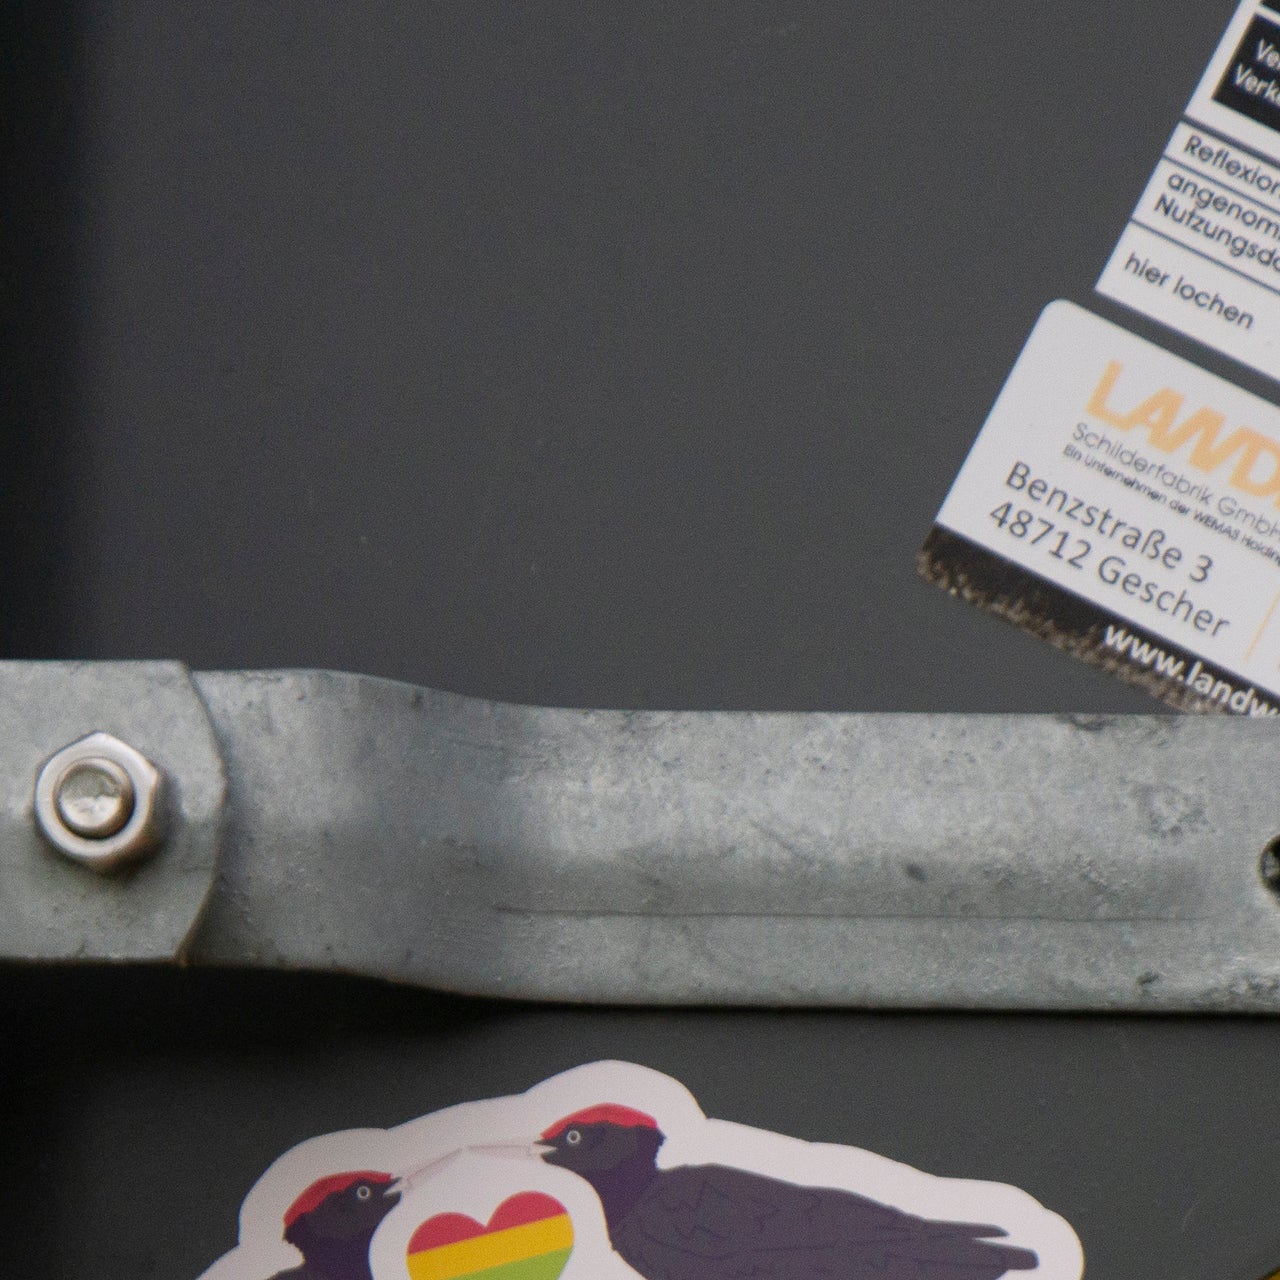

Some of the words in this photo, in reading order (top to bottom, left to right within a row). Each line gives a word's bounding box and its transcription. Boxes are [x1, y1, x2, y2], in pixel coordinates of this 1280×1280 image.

[1123, 252, 1170, 287] hier
[1173, 275, 1254, 330] lochen
[1072, 422, 1211, 506] Schilderfabrik
[1084, 453, 1167, 504] Unternehmen
[1005, 460, 1183, 569] Benzstraße
[1189, 554, 1214, 584] 3
[989, 501, 1092, 571] 48712
[1097, 555, 1231, 638] Gescher
